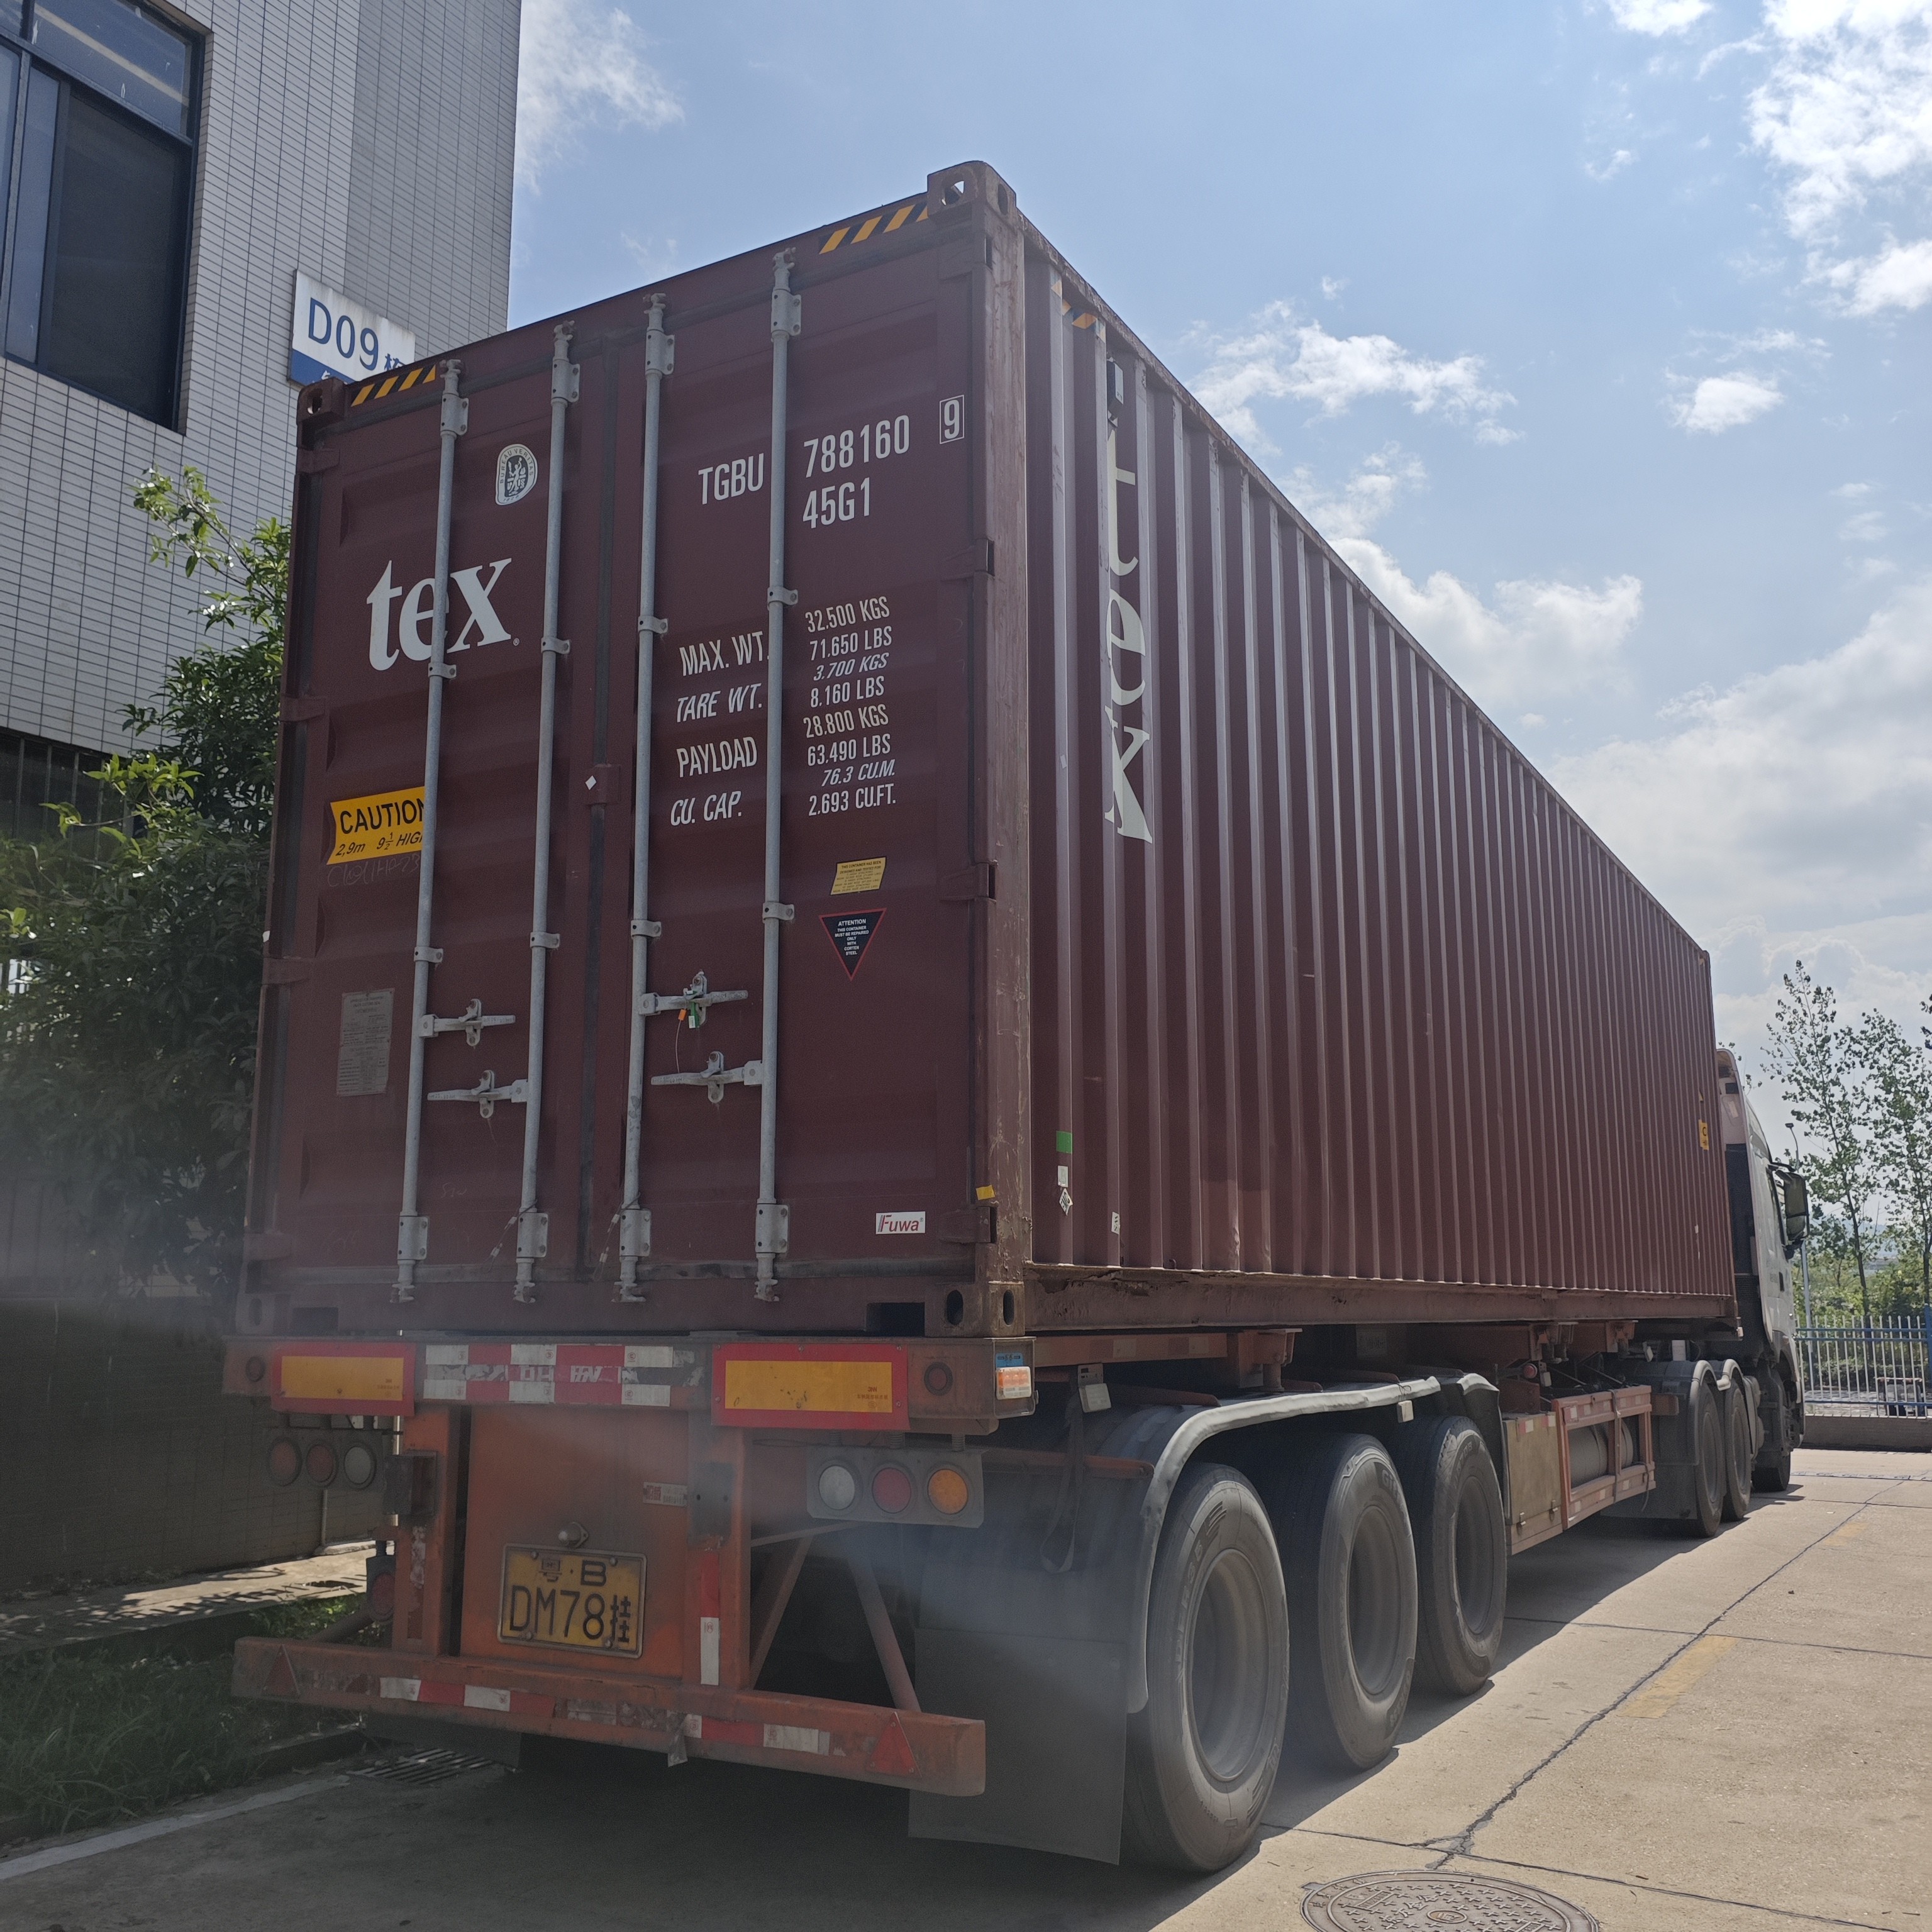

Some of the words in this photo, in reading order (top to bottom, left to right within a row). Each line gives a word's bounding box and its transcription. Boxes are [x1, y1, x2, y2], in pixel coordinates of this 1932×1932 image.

[698, 453, 764, 505] TGBU
[803, 414, 909, 478] 788160
[943, 399, 960, 439] 9
[802, 477, 870, 529] 45G1
[366, 558, 512, 671] tex
[859, 596, 890, 622] KGS
[864, 625, 892, 650] LBS
[679, 639, 730, 677] MAX.
[858, 652, 889, 672] KGS
[856, 675, 884, 700] LBS
[676, 691, 721, 723] TARE
[728, 683, 763, 713] WT.
[858, 704, 889, 729] KGS
[676, 736, 757, 778] PAYLOAD
[863, 733, 891, 757] LBS
[821, 766, 854, 786] 76.3
[670, 797, 696, 826] CU.
[703, 791, 743, 822] CAP.
[838, 918, 867, 926] ATTENTION
